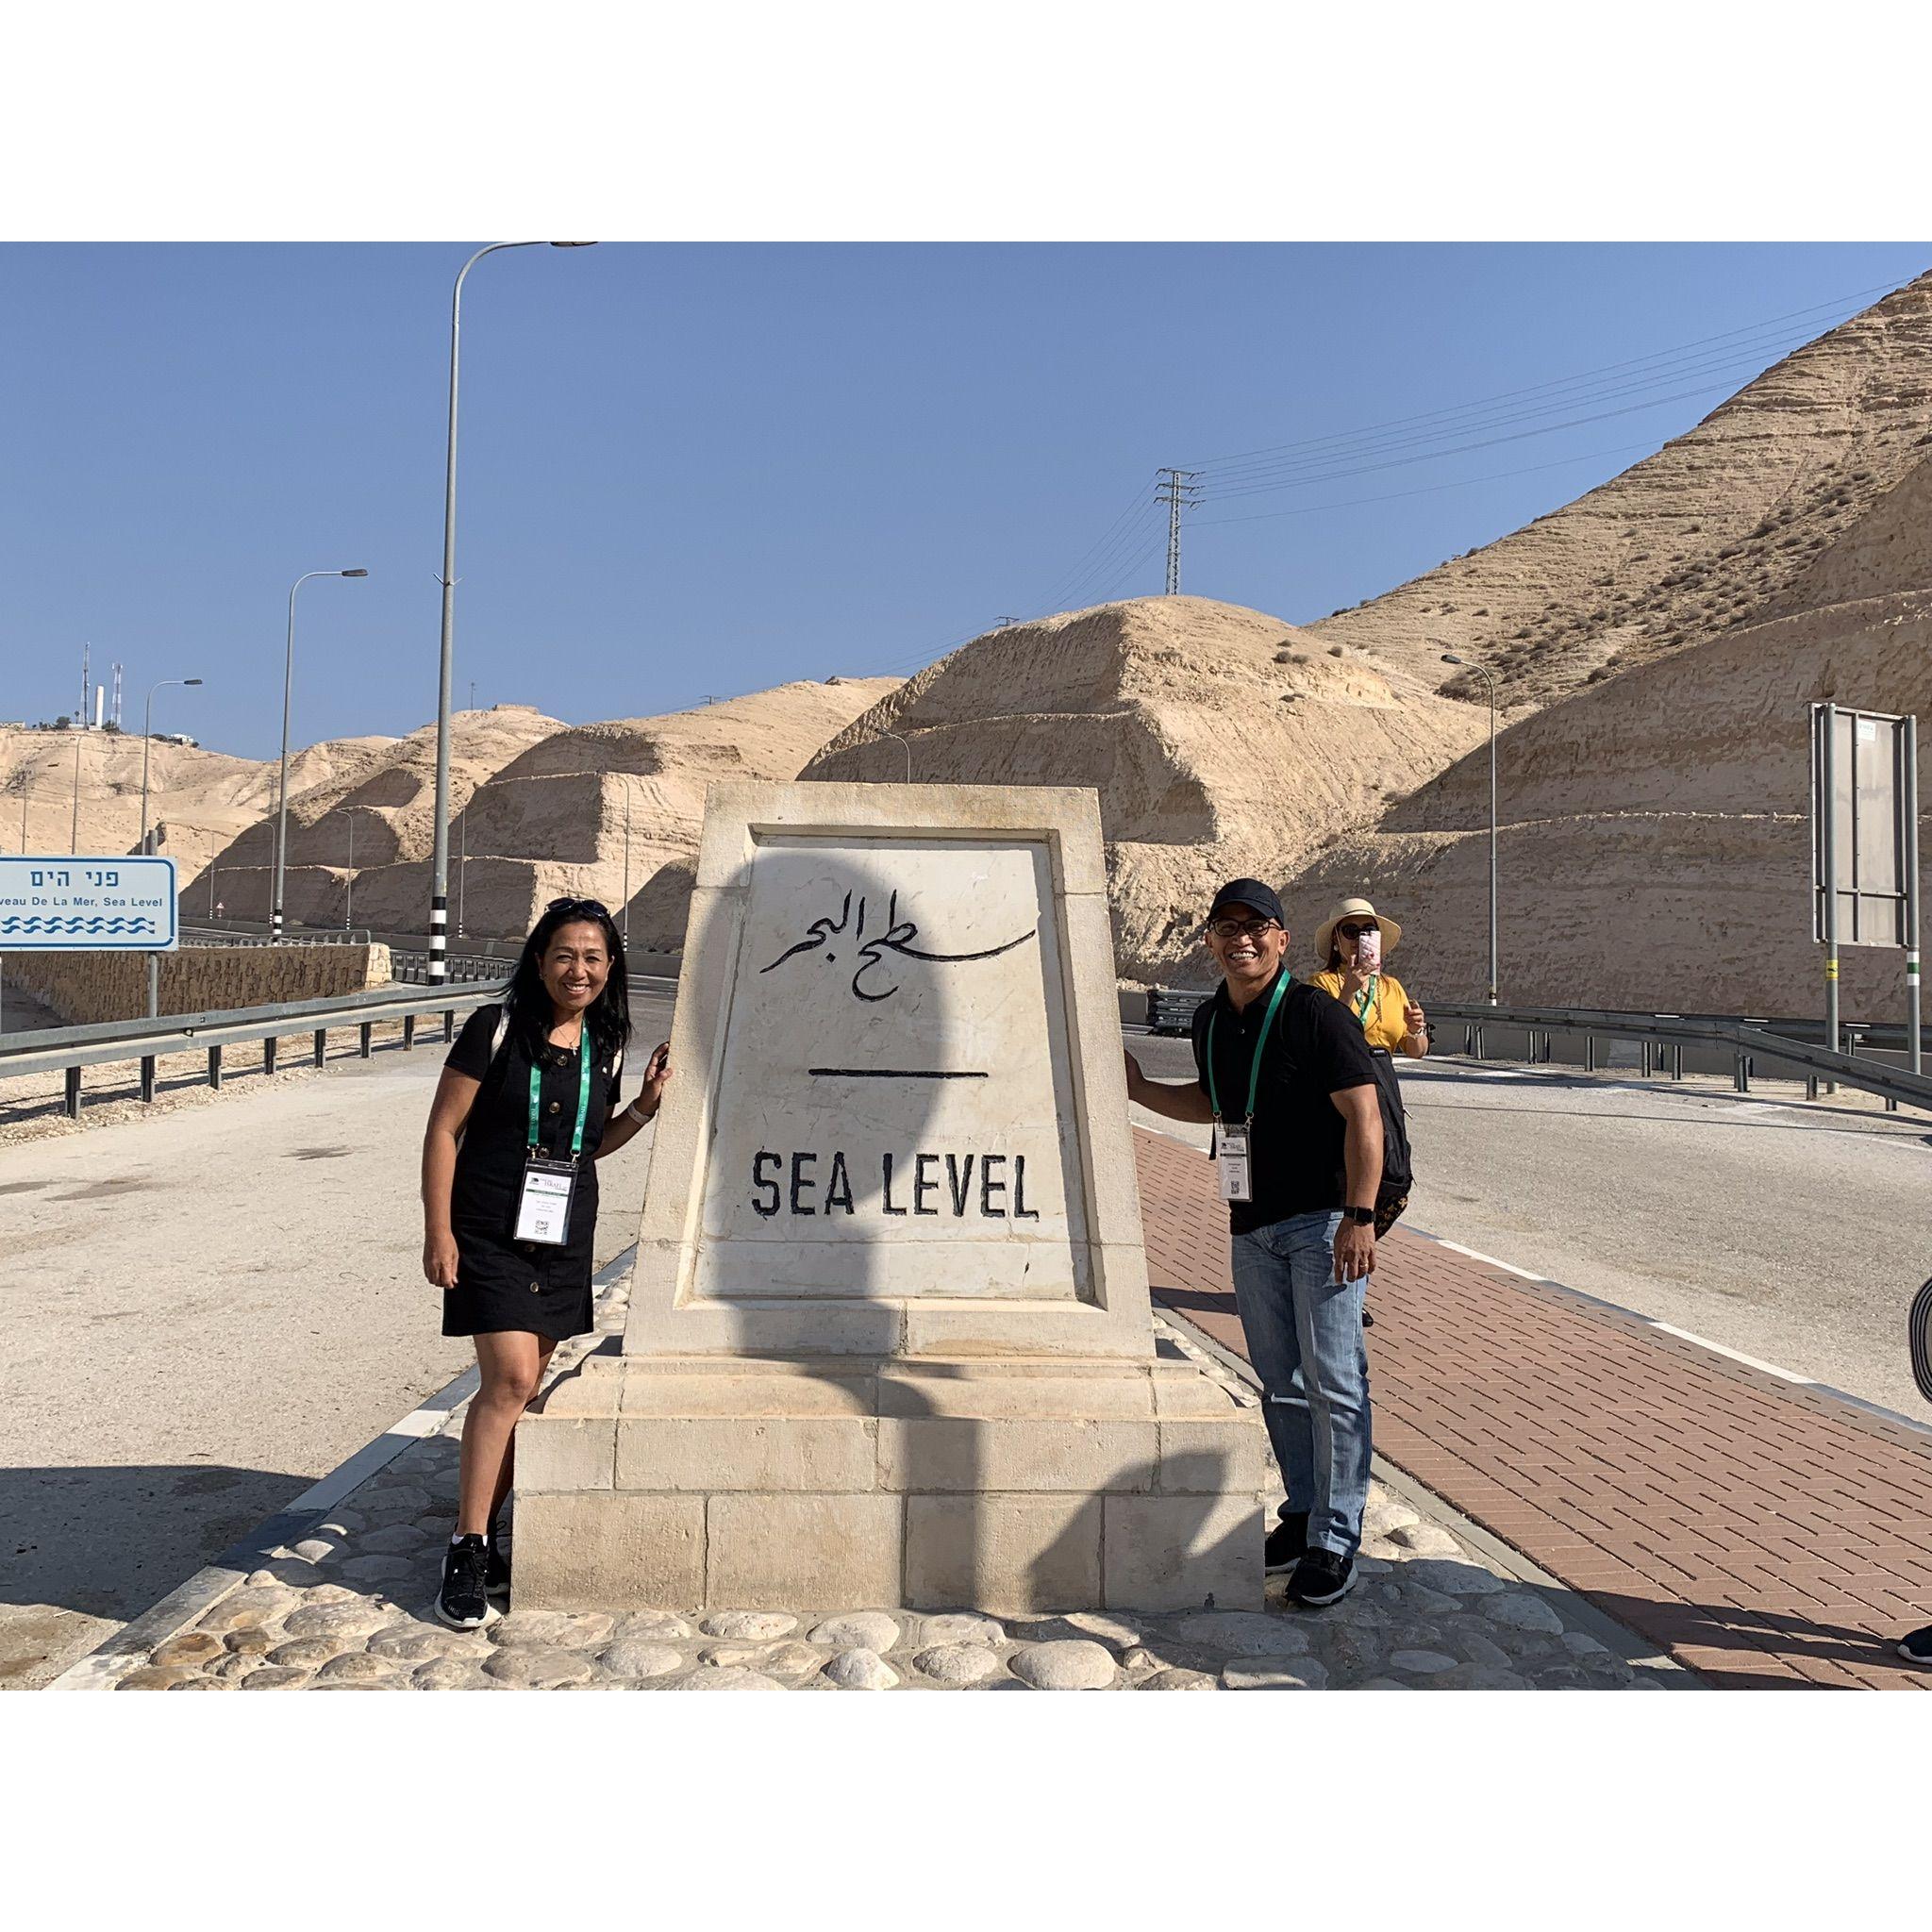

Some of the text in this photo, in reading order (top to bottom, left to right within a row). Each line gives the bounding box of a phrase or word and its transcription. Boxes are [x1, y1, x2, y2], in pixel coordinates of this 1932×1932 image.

[30, 871, 119, 887] פני הים
[31, 896, 48, 906] De
[53, 896, 68, 906] La
[73, 897, 98, 908] Mer,
[103, 897, 125, 907] Sea
[131, 897, 162, 907] Level
[852, 888, 1036, 1003] سطح
[752, 1150, 1040, 1219] SEA LEVEL
